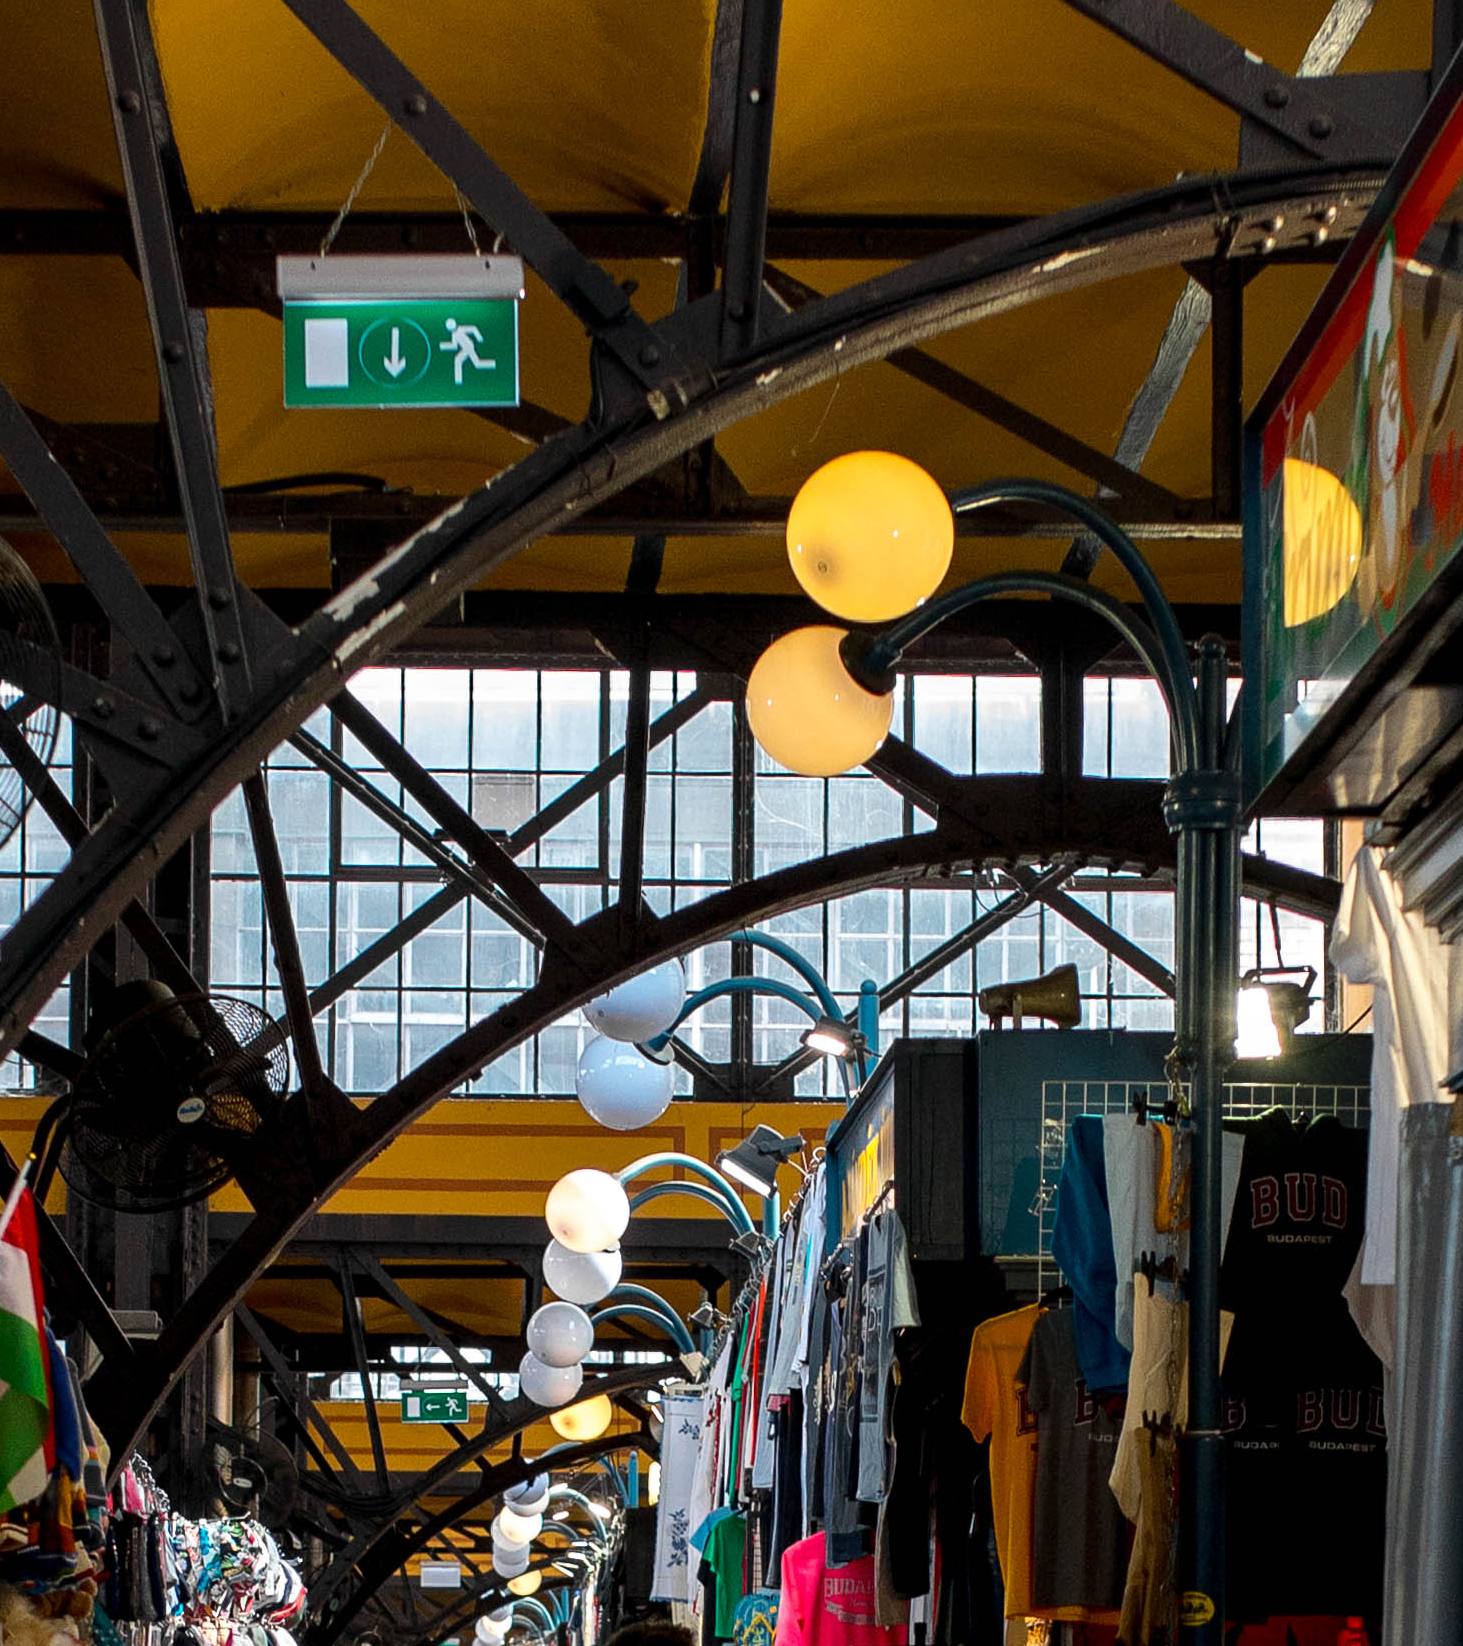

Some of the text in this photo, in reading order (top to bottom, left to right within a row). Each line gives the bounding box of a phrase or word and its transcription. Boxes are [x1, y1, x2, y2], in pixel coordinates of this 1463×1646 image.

[1250, 1172, 1348, 1229] BUD
[1267, 1234, 1333, 1244] BUDAPEST
[1308, 1441, 1376, 1453] BUDAPEST
